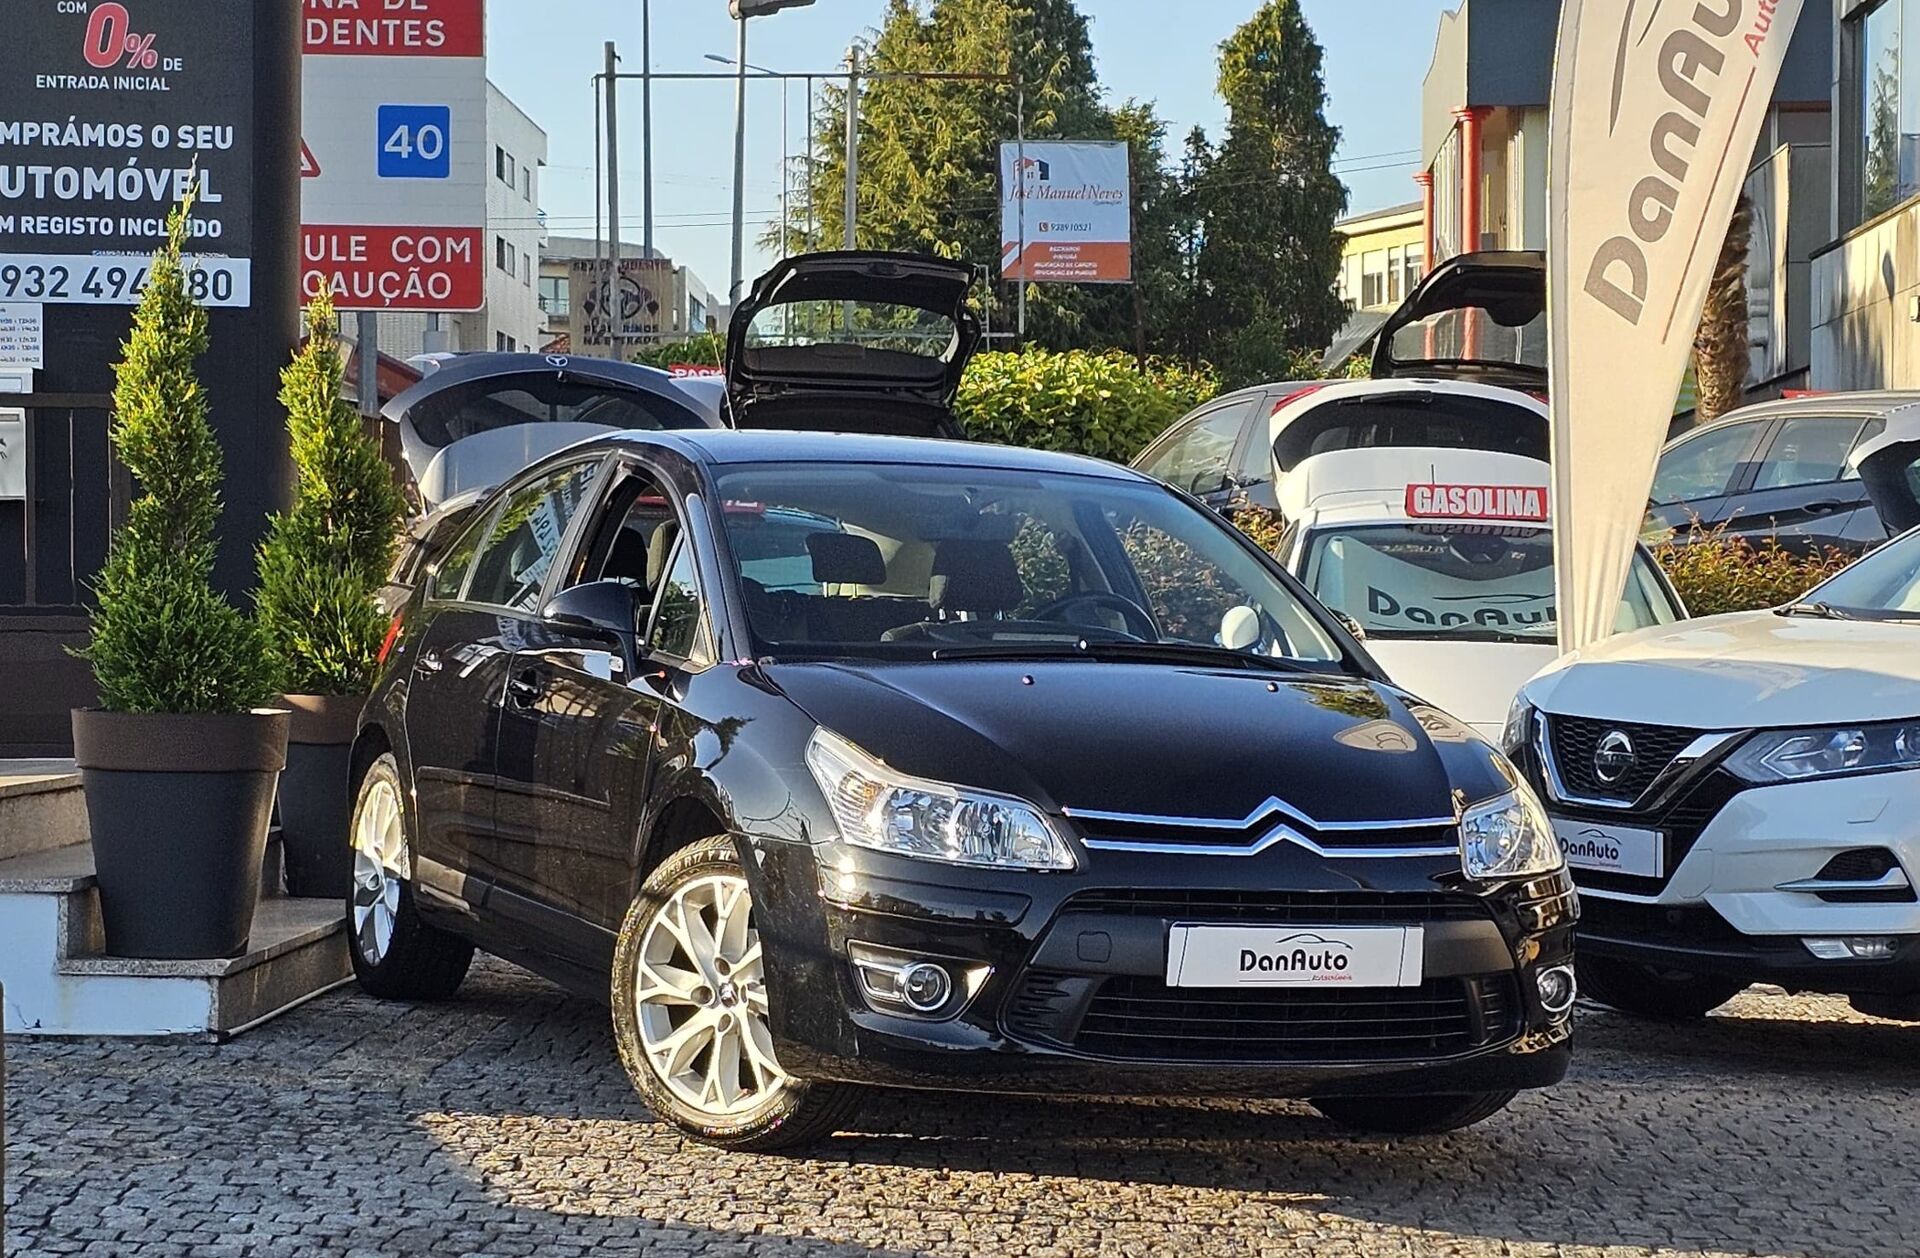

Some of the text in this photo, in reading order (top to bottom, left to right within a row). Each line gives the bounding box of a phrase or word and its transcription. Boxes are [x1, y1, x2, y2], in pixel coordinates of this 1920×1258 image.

[57, 1, 183, 71] COM 0% DE
[306, 18, 446, 47] DENTES
[1744, 0, 1780, 58] Aut
[36, 74, 170, 91] ENTRADA INICIAL
[151, 124, 170, 148] O
[177, 125, 233, 149] SEU
[384, 124, 443, 160] 40
[1037, 183, 1086, 200] Manuel
[1087, 183, 1124, 200] Neves
[21, 216, 114, 236] REGISTO
[120, 213, 222, 238] INCLÍDO
[304, 234, 471, 264] ULE COM
[1, 265, 69, 298] 932
[81, 266, 148, 300] 494
[303, 266, 452, 307] CAUÇÃO
[1413, 486, 1541, 517] GASOLINA
[1560, 836, 1619, 861] DanAuto
[1240, 949, 1349, 972] DanAuto
